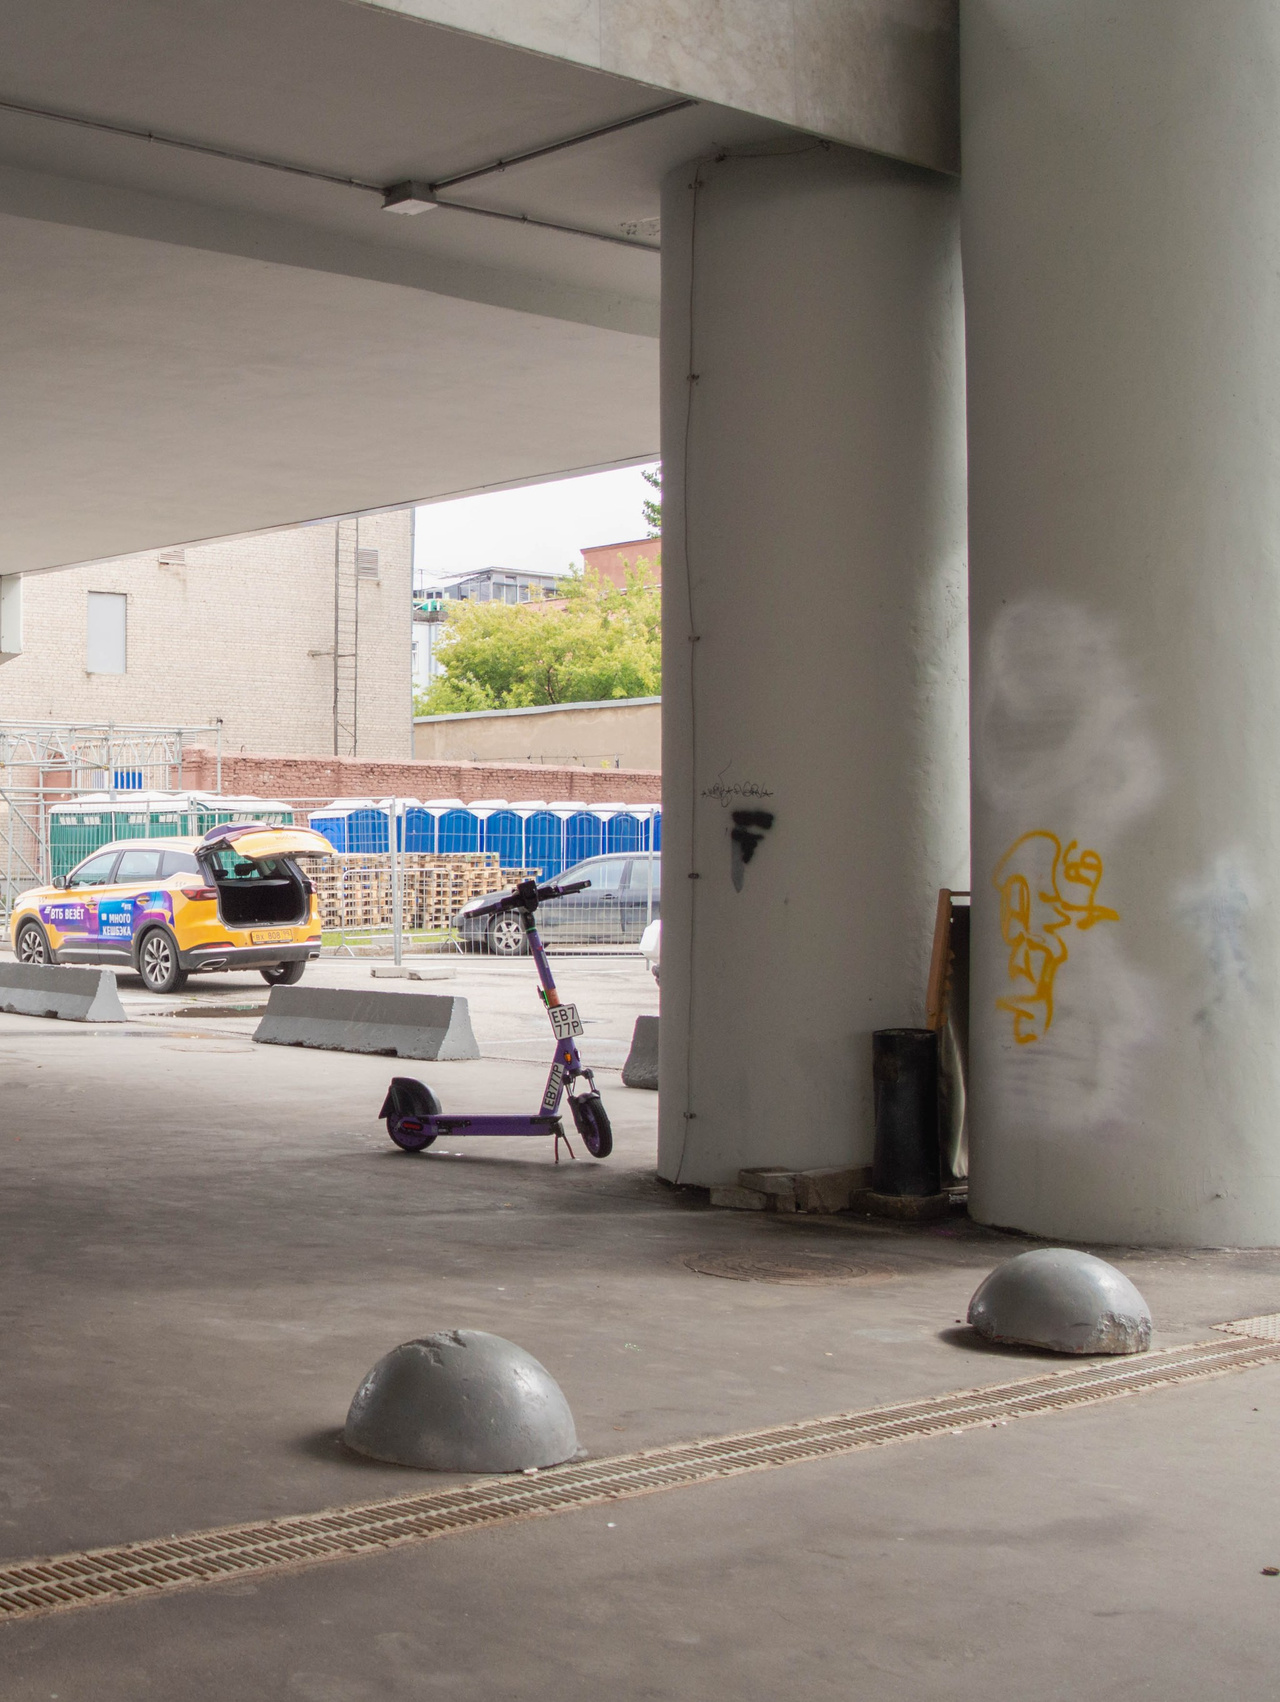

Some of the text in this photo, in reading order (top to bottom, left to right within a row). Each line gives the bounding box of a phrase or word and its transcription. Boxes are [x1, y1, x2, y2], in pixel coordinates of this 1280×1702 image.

[50, 906, 85, 920] ВТБ ВЕЗЁТ
[108, 913, 131, 924] МНОГО
[102, 926, 132, 937] КЕШБЭКА
[551, 1006, 575, 1024] EB7
[555, 1020, 580, 1038] 77P
[544, 1064, 562, 1108] EB777P
